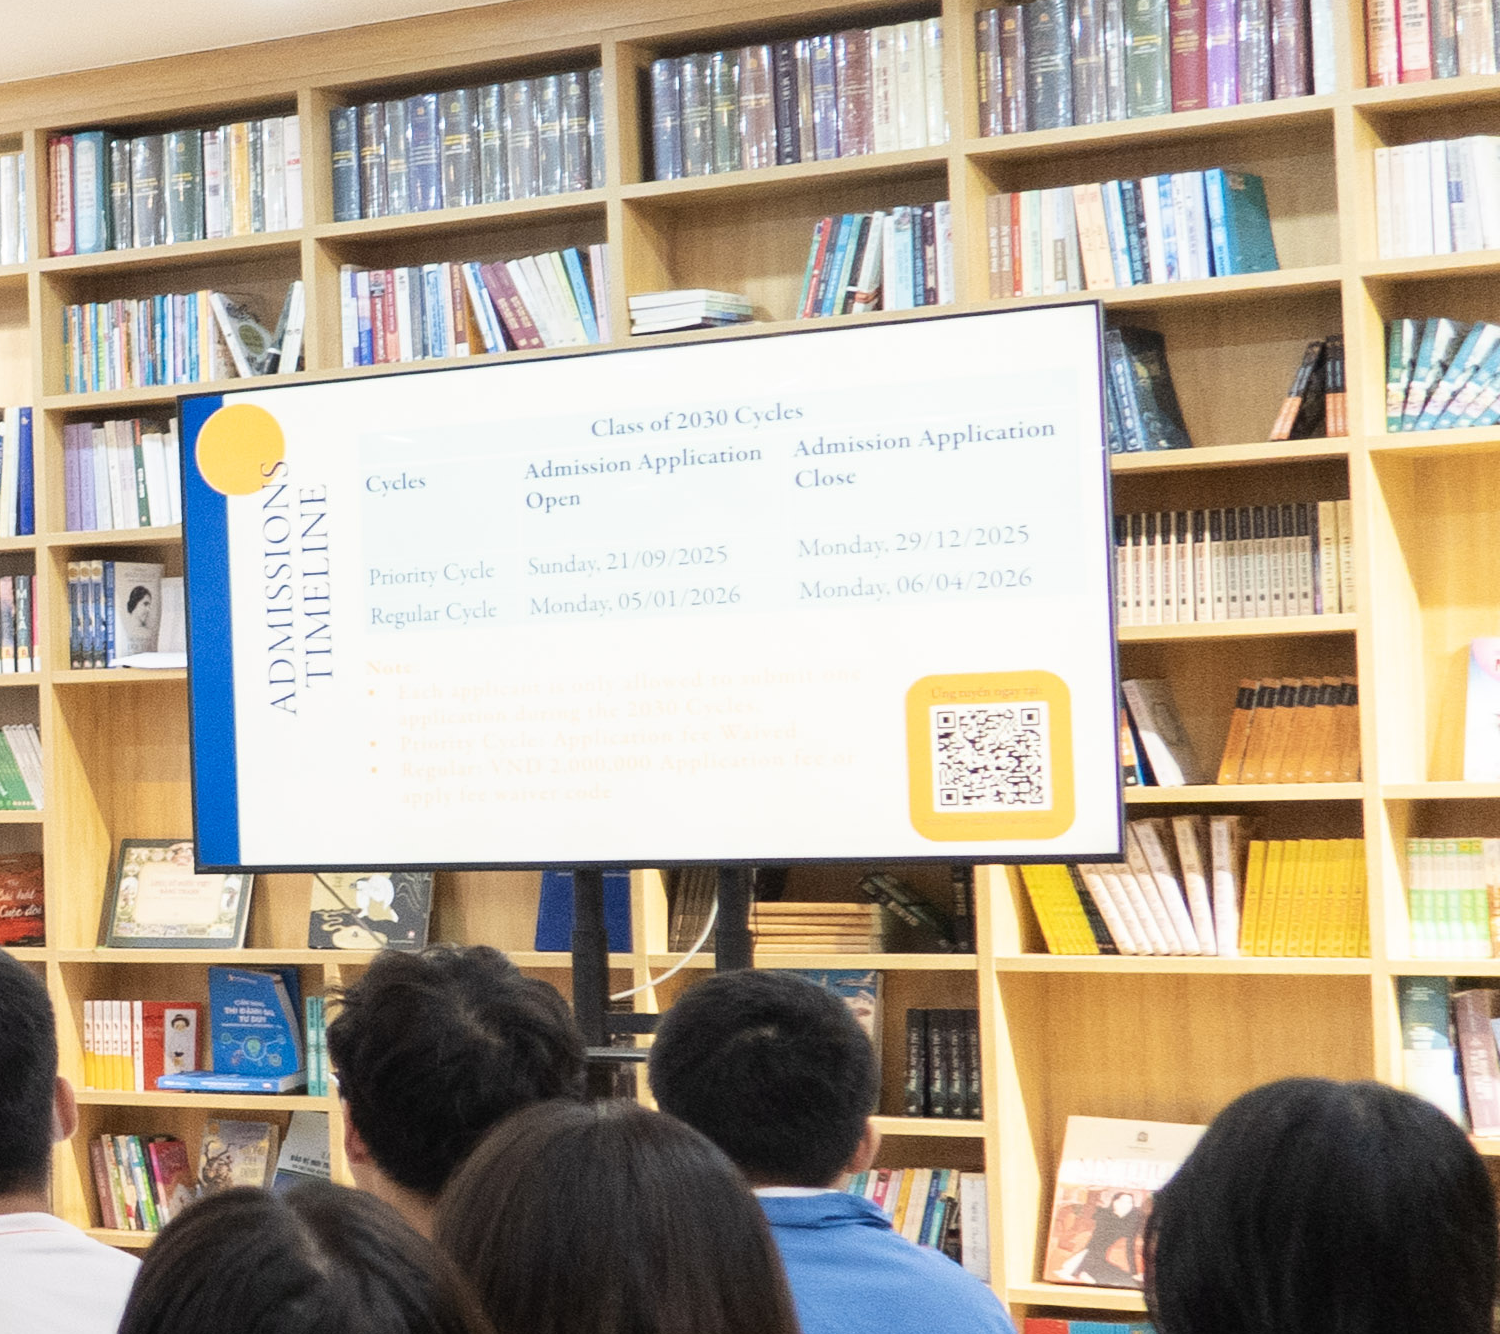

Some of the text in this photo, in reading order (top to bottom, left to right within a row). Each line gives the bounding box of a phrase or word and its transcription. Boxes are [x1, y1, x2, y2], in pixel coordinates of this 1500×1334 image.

[590, 402, 805, 439] Class of 2030 Cycles
[793, 421, 1056, 457] Admission Application
[524, 444, 763, 480] Admission Application
[365, 472, 427, 497] Cycles
[794, 468, 857, 489] Close
[525, 490, 582, 514] Open
[895, 524, 1031, 553] 29/12/2025
[606, 544, 729, 571] 21/09/2025
[261, 459, 299, 718] ADMISSIONS
[298, 480, 331, 689] TIMELINE
[368, 560, 495, 588] Priority Cycle
[896, 566, 1033, 595] 06/04/2026
[617, 584, 742, 610] 05/01/2026
[370, 600, 499, 630] Regular Cycle
[451, 679, 542, 704] applicant
[572, 676, 616, 698] only
[398, 706, 508, 730] application
[514, 702, 581, 725] during
[587, 702, 620, 720] the
[626, 699, 678, 718] 2030
[398, 732, 474, 756] Priority
[553, 724, 673, 752] Application
[490, 757, 542, 776] VND
[659, 748, 787, 776] Application
[401, 786, 453, 810] apply
[494, 785, 560, 803] waiver
[563, 782, 614, 802] code
